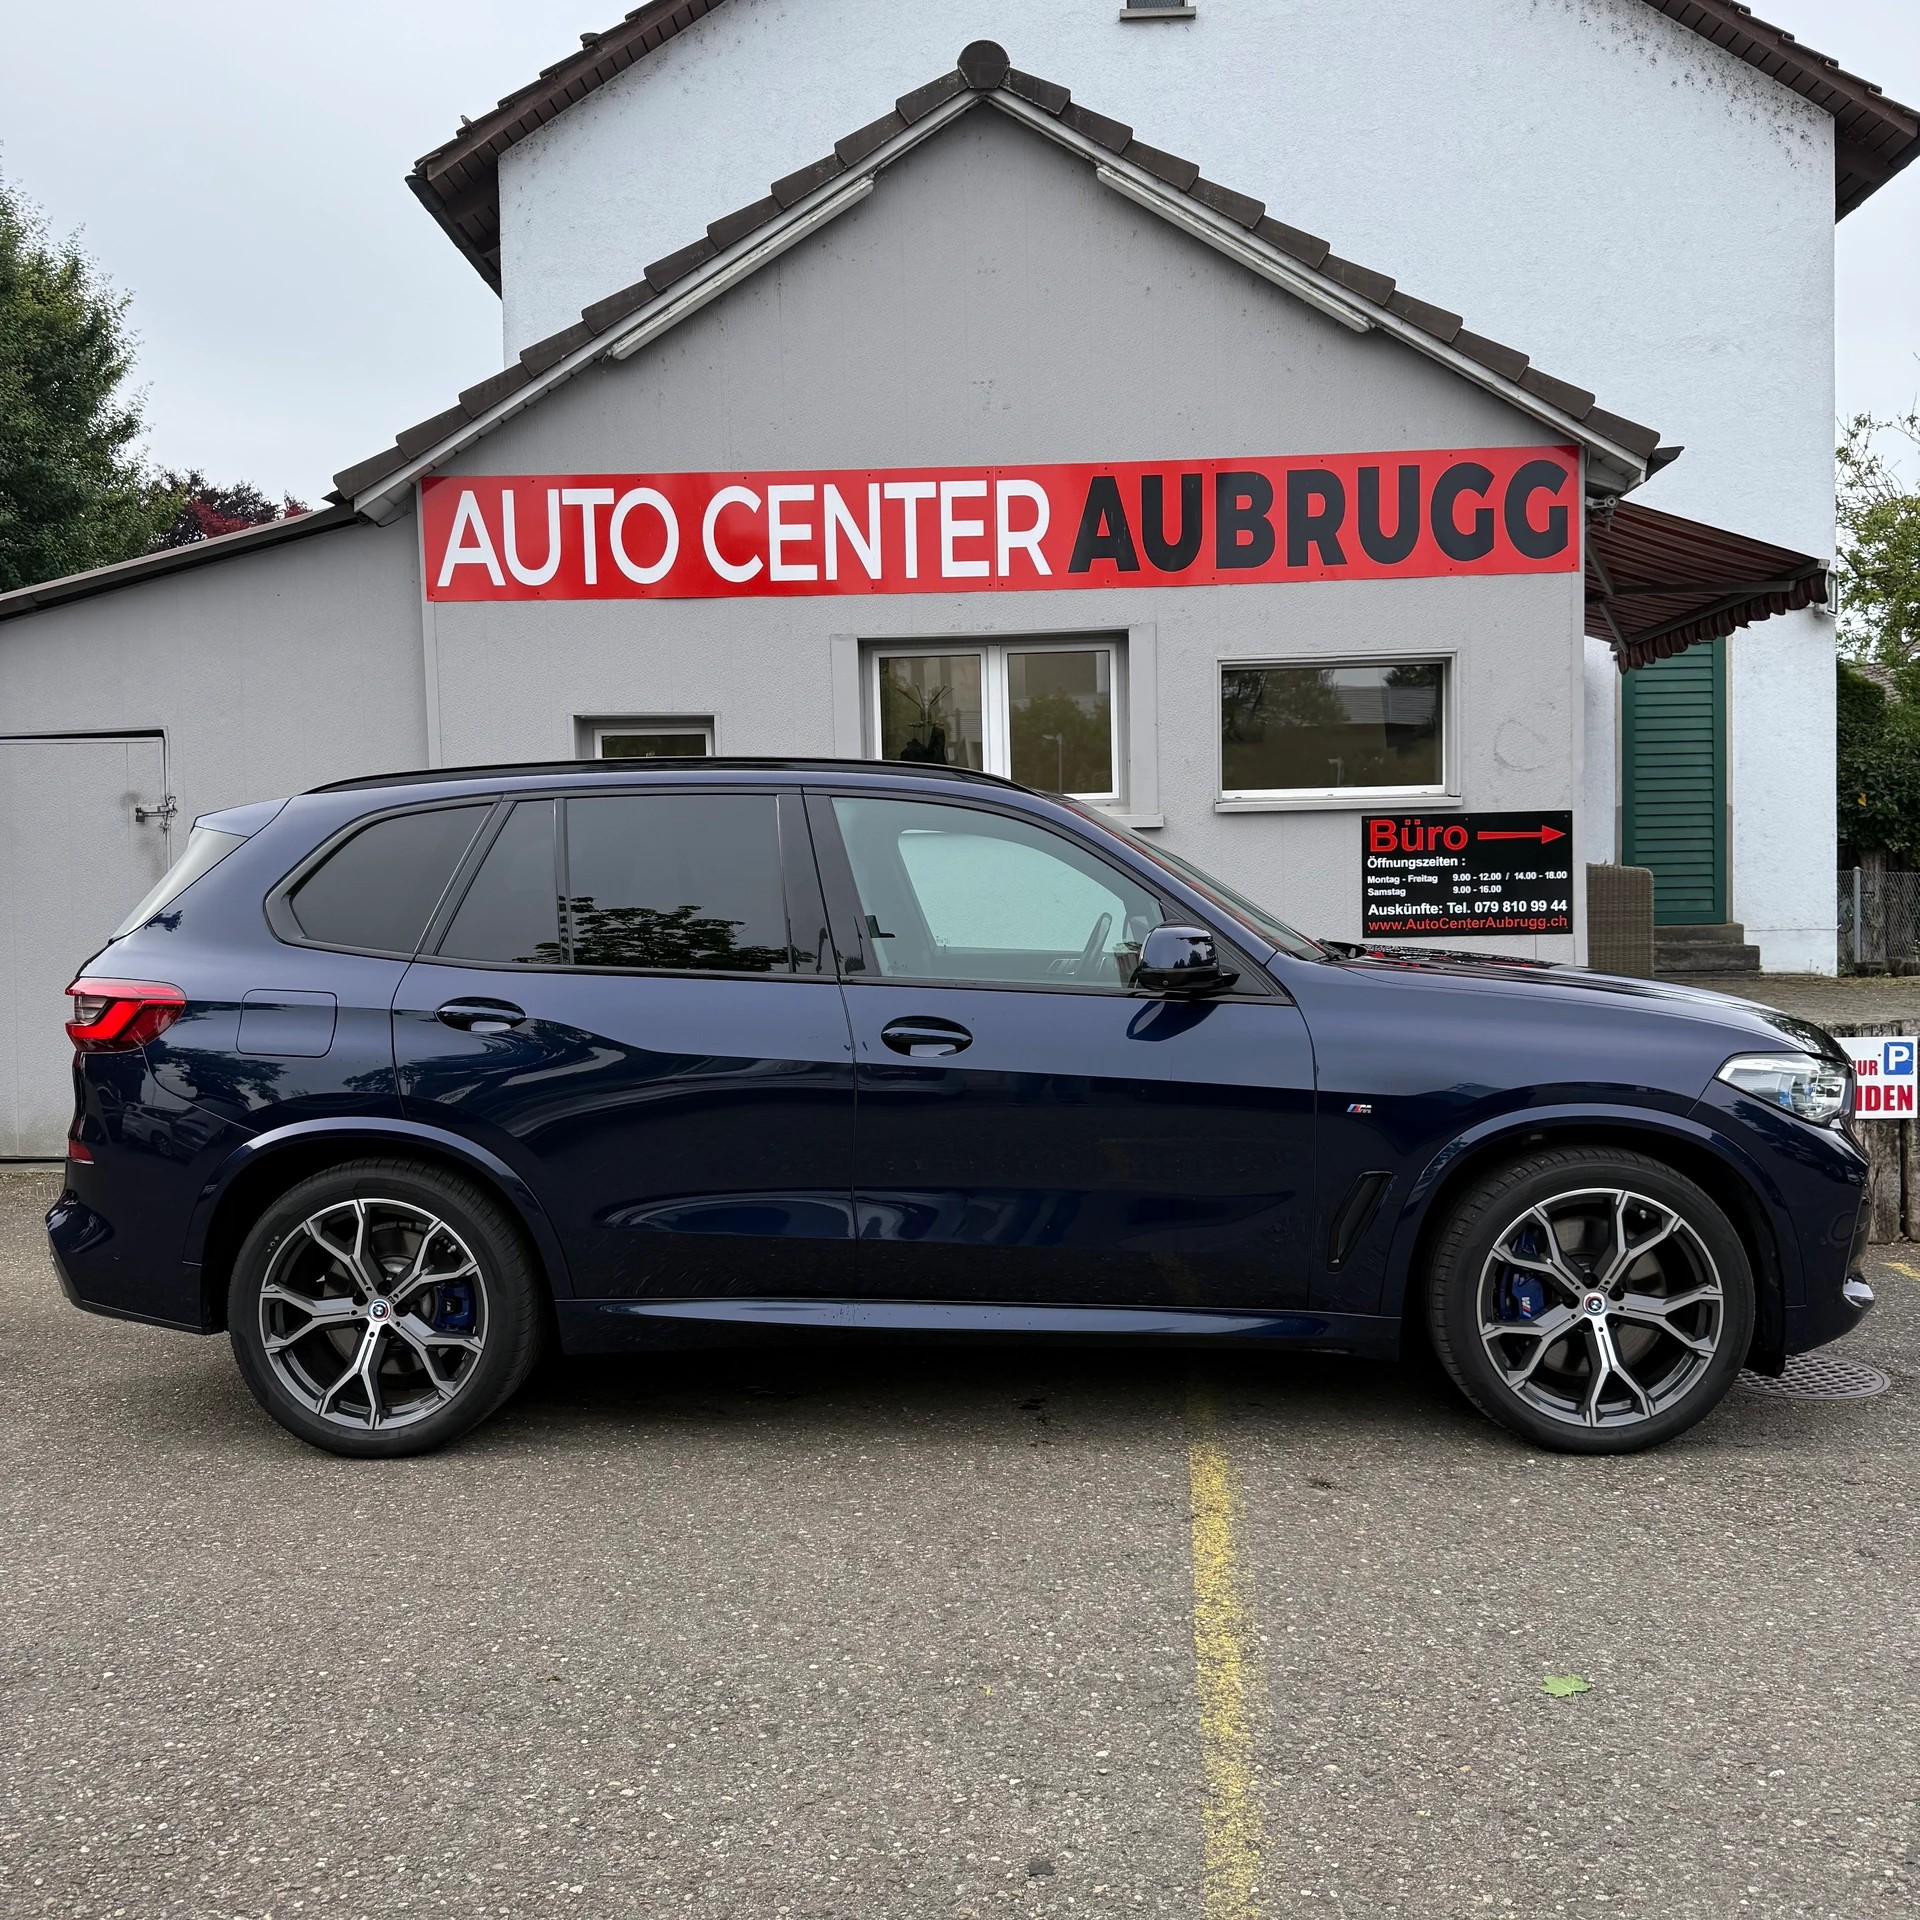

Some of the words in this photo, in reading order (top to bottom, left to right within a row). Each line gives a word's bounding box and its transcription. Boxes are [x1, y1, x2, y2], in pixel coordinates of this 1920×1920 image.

[437, 487, 680, 587] AUTO
[702, 479, 1053, 583] CENTER
[1067, 459, 1569, 574] AUBRUGG
[1370, 819, 1468, 852] Büro
[1367, 855, 1458, 870] Öffnungszeiten
[1367, 875, 1400, 885] Montag
[1407, 874, 1439, 884] Freitag
[1452, 873, 1471, 881] 9.00
[1479, 872, 1502, 880] 12.00
[1514, 871, 1537, 880] 14.00
[1544, 870, 1568, 879] 18.00
[1367, 887, 1406, 897] Samstag
[1452, 885, 1471, 894] 9.00
[1479, 884, 1502, 893] 16.00
[1367, 903, 1443, 915] Auskünfte:
[1446, 901, 1471, 914] Tel.
[1474, 901, 1499, 913] 079
[1502, 900, 1527, 912] 810
[1530, 900, 1547, 912] 99
[1550, 899, 1568, 911] 44
[1368, 915, 1568, 930] www.AutoCenterAubrugg.ch
[1889, 1046, 1910, 1070] P
[1854, 1060, 1878, 1076] UR
